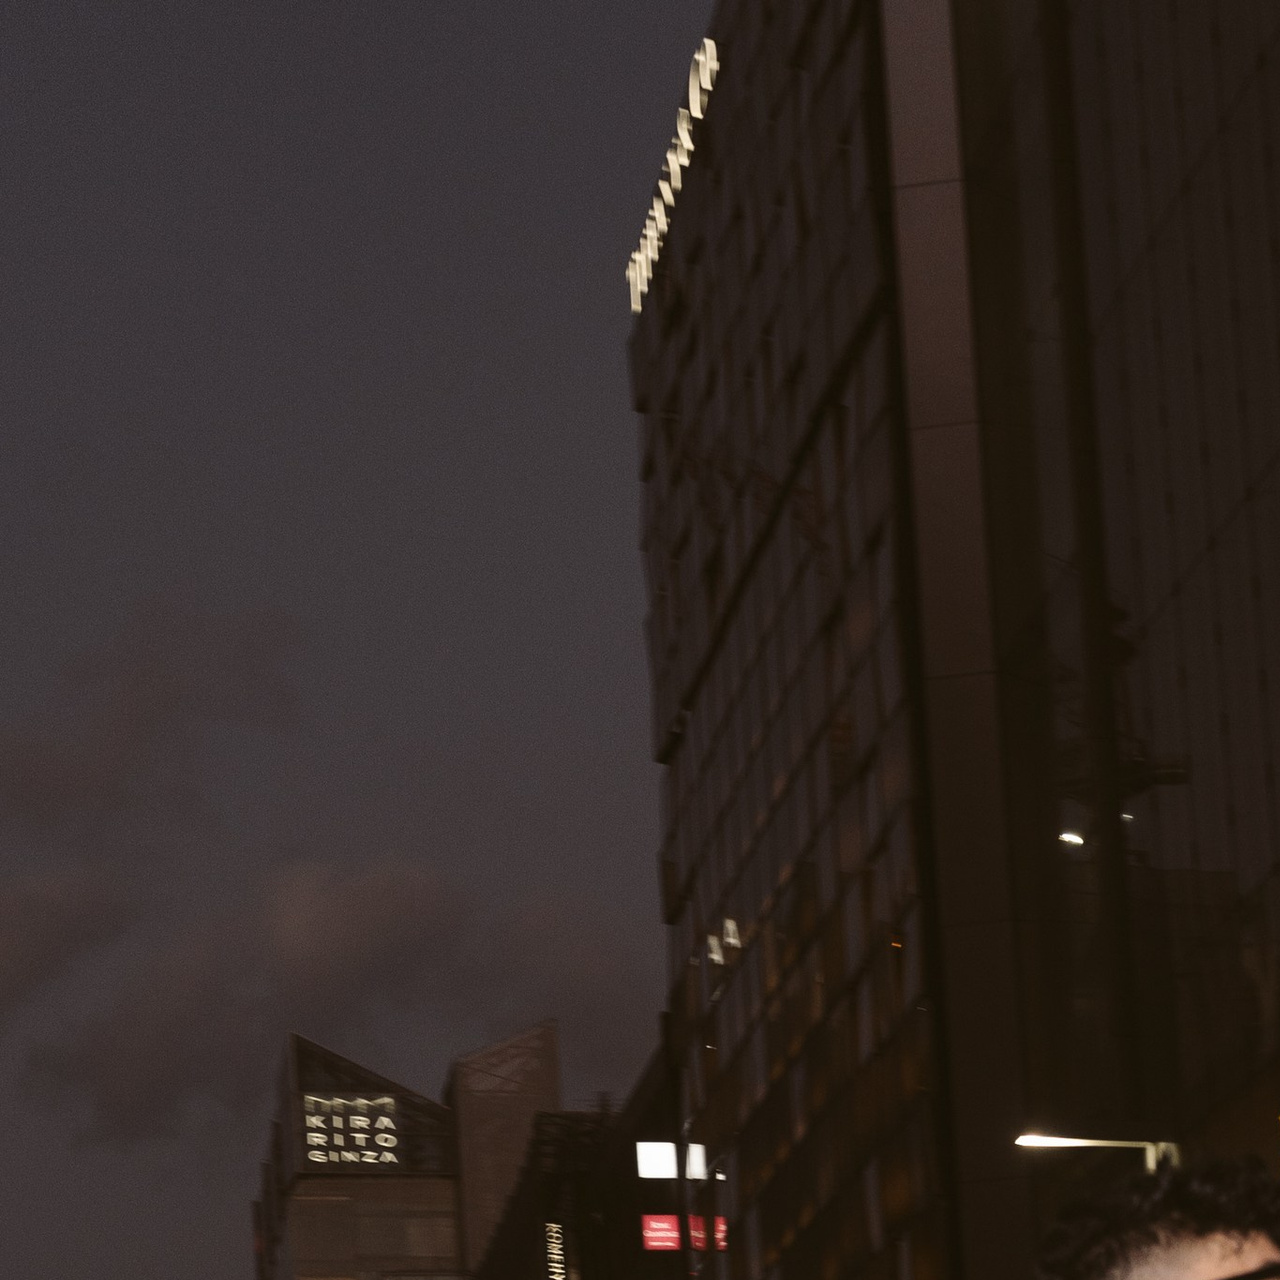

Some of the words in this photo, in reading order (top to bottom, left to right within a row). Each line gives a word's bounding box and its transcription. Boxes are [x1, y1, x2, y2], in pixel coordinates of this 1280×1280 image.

[304, 1114, 397, 1130] KIRA
[306, 1132, 398, 1148] RITO
[307, 1150, 399, 1163] GINZA
